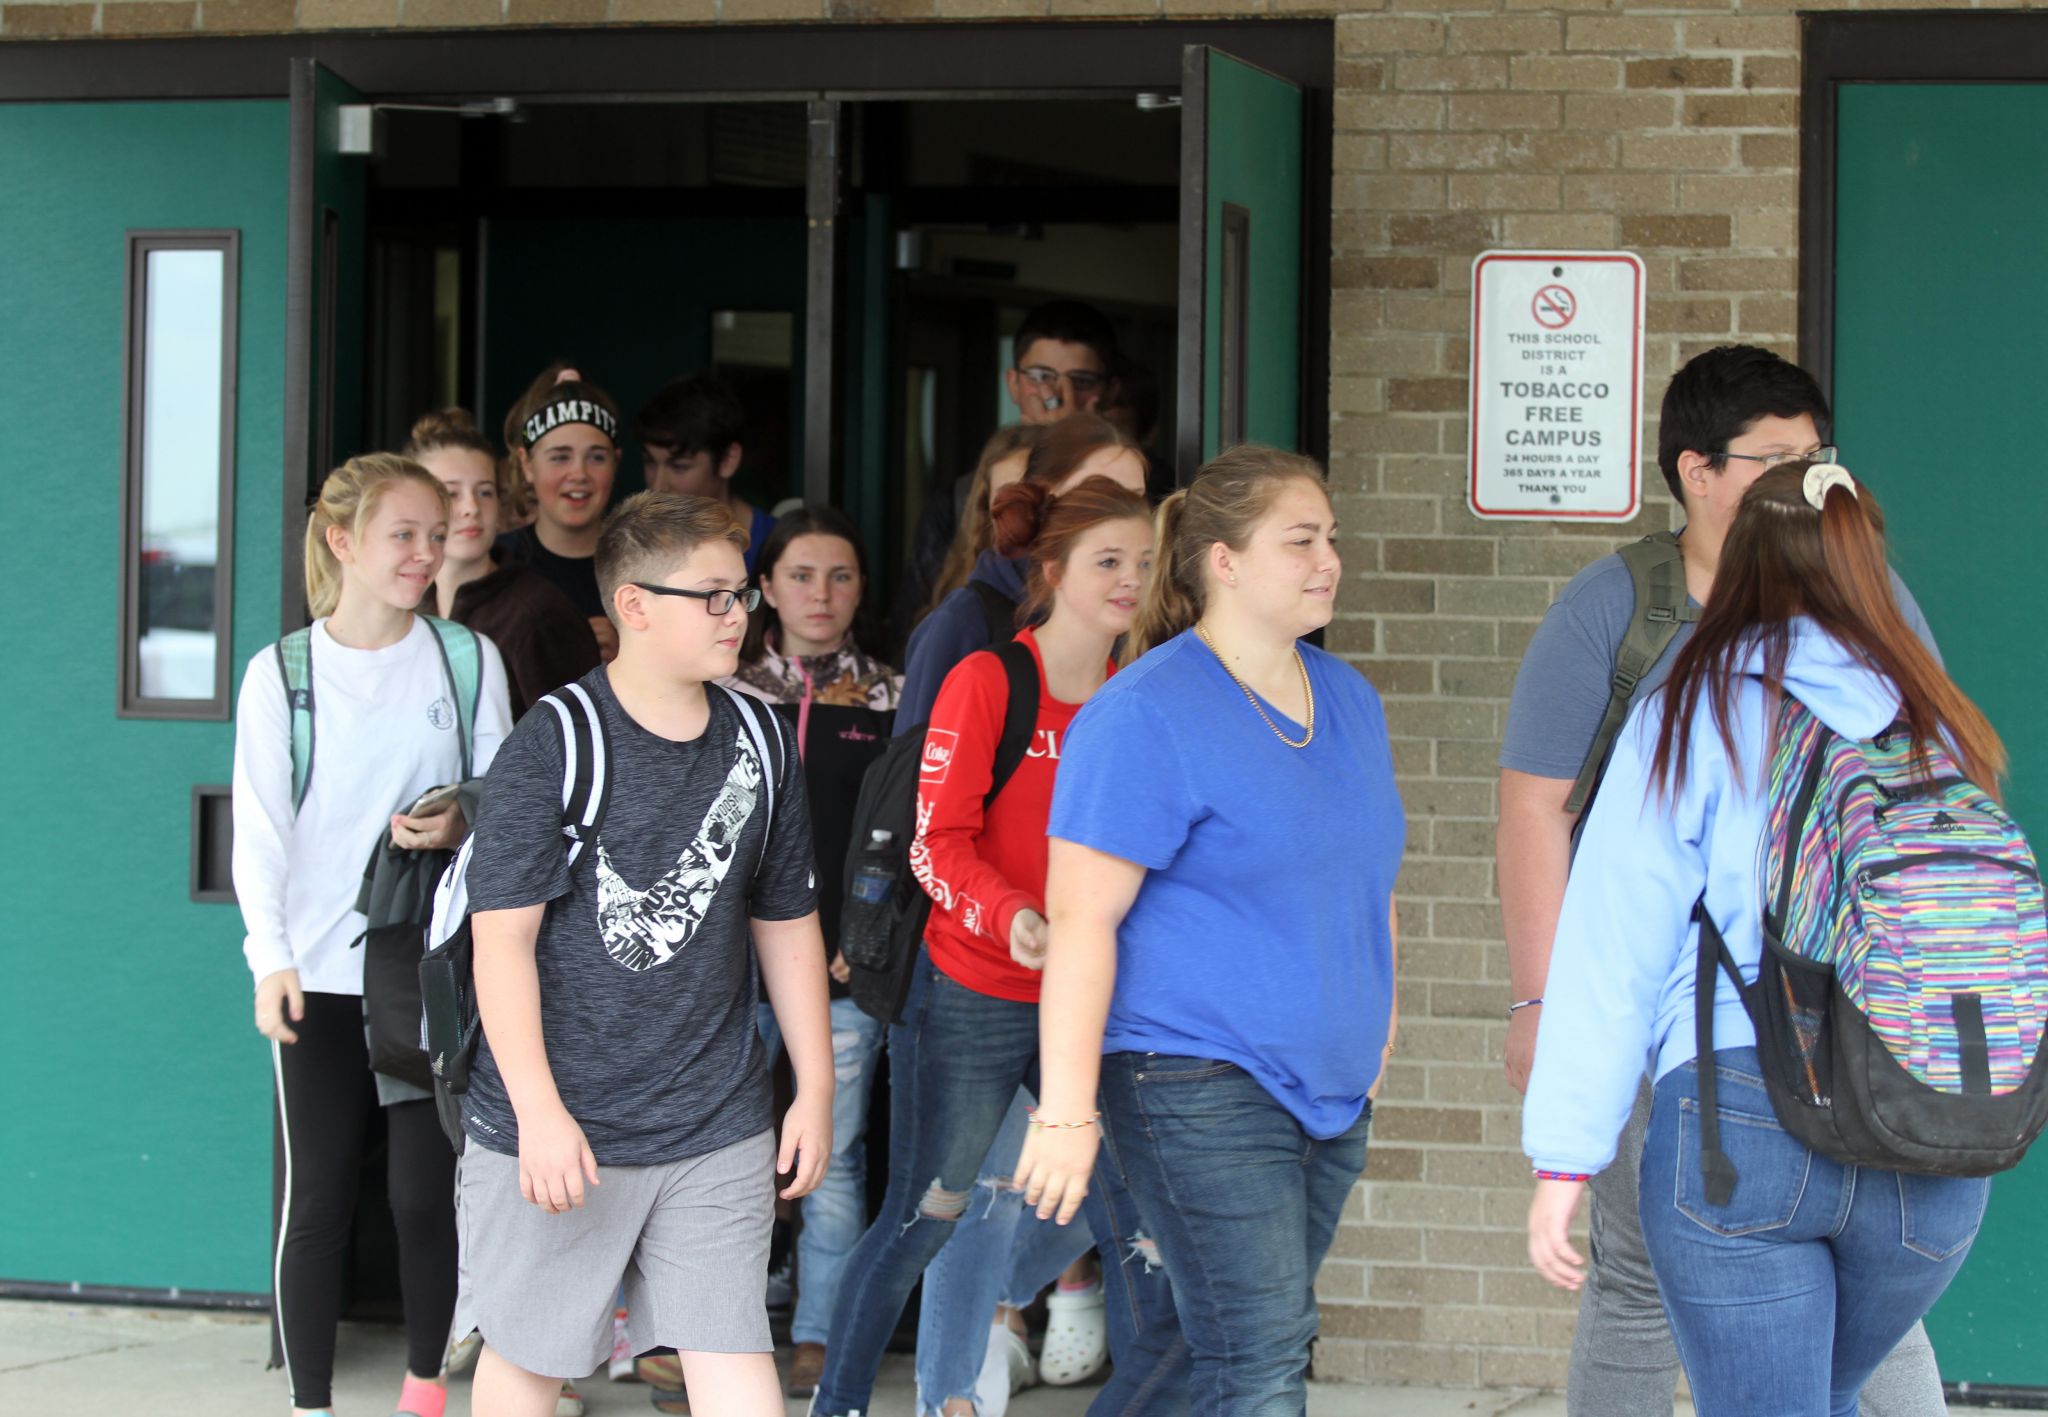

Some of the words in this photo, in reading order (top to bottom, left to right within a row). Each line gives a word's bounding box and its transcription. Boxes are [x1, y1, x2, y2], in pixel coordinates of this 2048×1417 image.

[1508, 333, 1540, 345] THIS
[1544, 333, 1602, 345] SCHOOL
[1522, 350, 1586, 361] DISTRICT
[1540, 365, 1554, 376] IS
[1558, 365, 1568, 376] A
[1500, 381, 1609, 399] TOBACCO
[1525, 406, 1582, 423] FREE
[1505, 429, 1602, 447] CAMPUS
[1504, 453, 1518, 464] 24
[1521, 453, 1562, 464] HOURS
[1566, 454, 1574, 464] A
[1577, 454, 1600, 465] DAY
[1502, 468, 1523, 478] 365
[1526, 468, 1556, 478] DAYS
[1560, 468, 1567, 478] A
[1570, 468, 1601, 479] YEAR
[1518, 484, 1559, 494] THANK
[1563, 484, 1587, 495] YOU
[925, 741, 951, 762] Coke
[607, 932, 653, 972] NIKE
